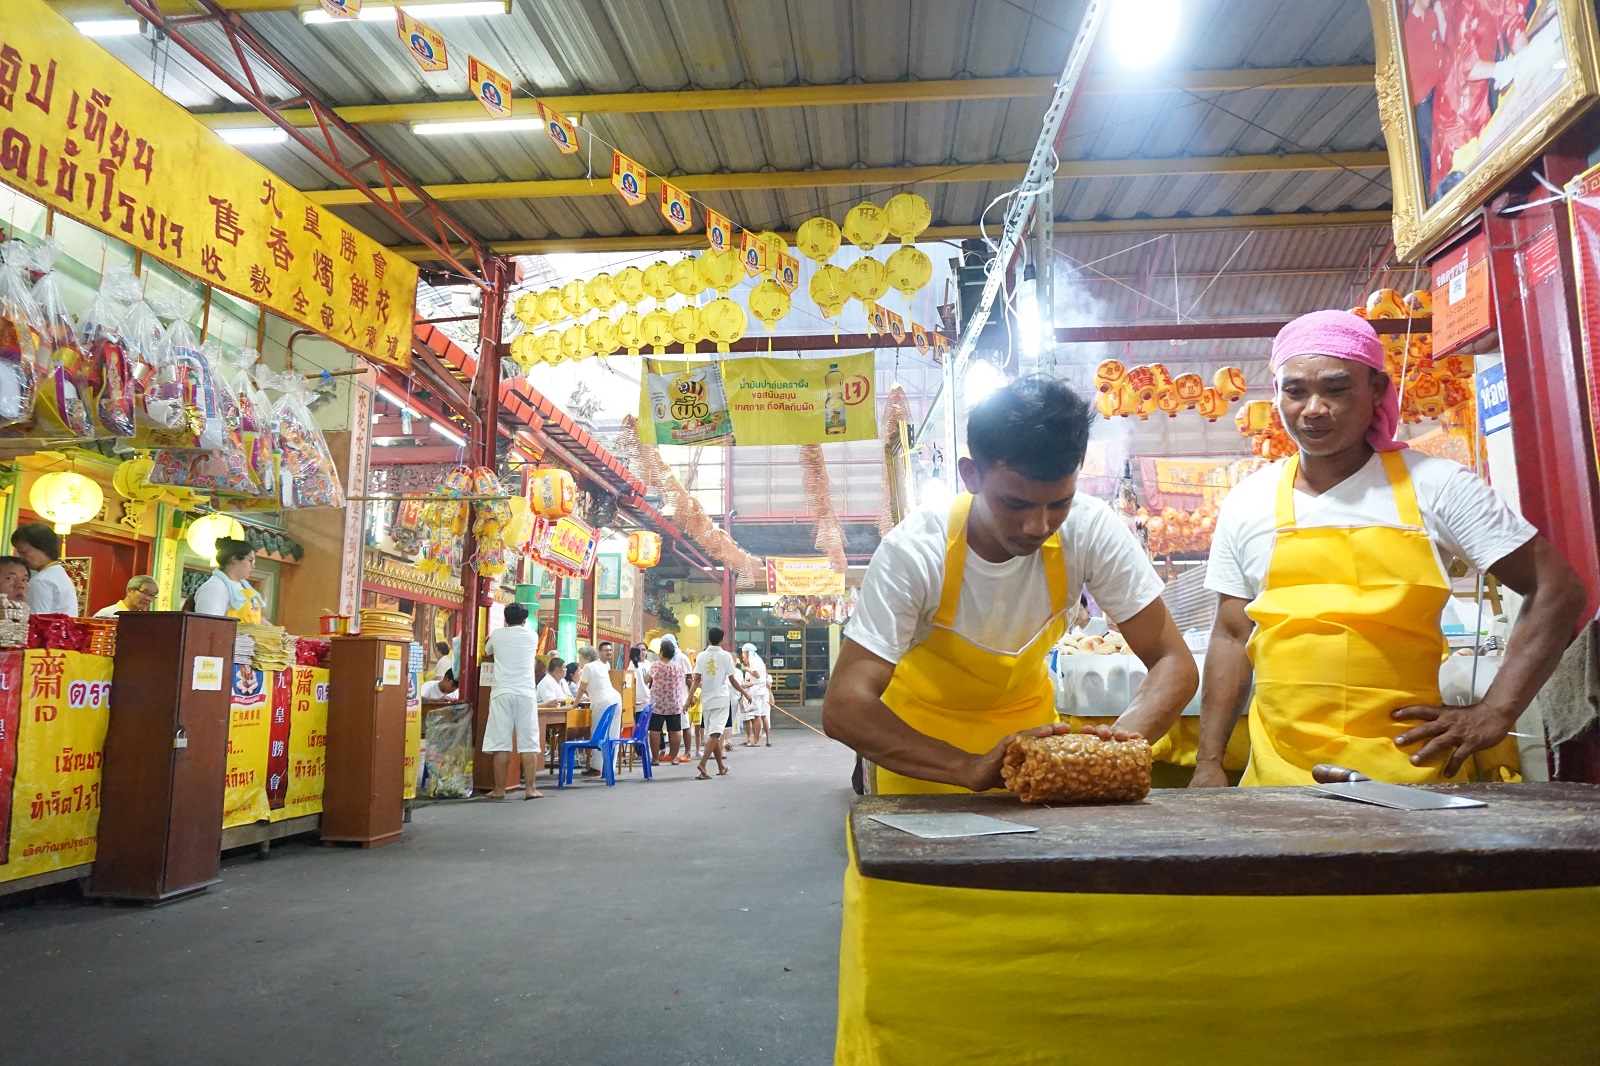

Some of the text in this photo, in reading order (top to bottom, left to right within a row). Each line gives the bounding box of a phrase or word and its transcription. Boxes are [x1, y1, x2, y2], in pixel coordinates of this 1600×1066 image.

[34, 704, 58, 723] เจ
[269, 673, 287, 791] 九皇勝會
